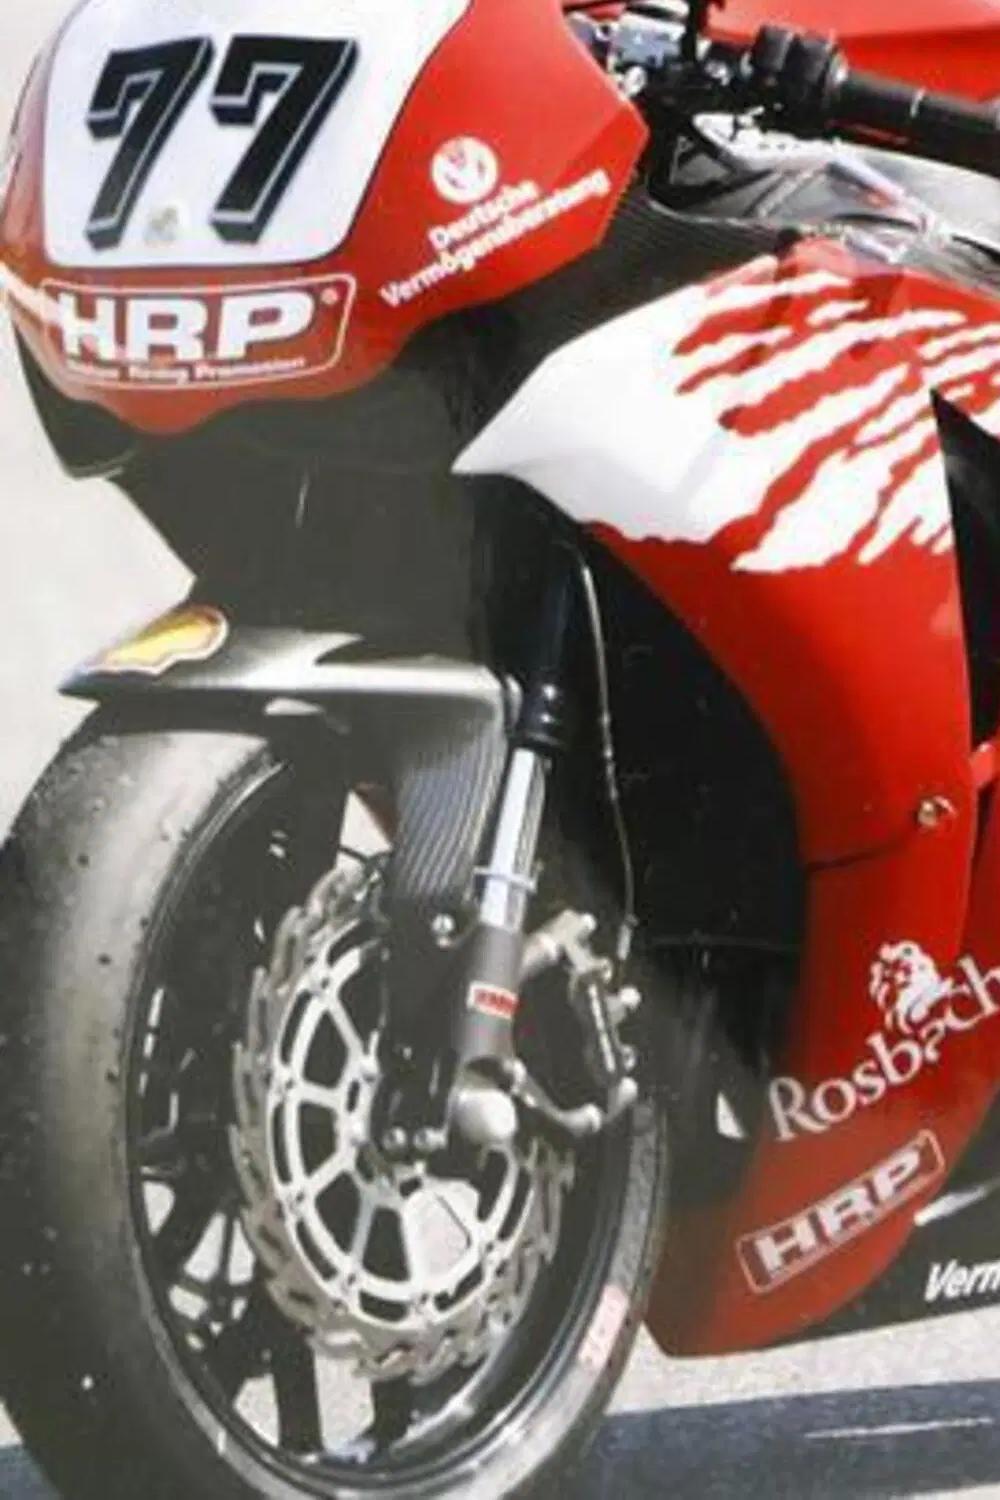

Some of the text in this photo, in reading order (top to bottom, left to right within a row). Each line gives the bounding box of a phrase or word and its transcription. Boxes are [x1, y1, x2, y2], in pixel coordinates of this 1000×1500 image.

[86, 35, 360, 251] 77
[56, 290, 315, 361] HRP
[755, 1149, 920, 1274] HRP
